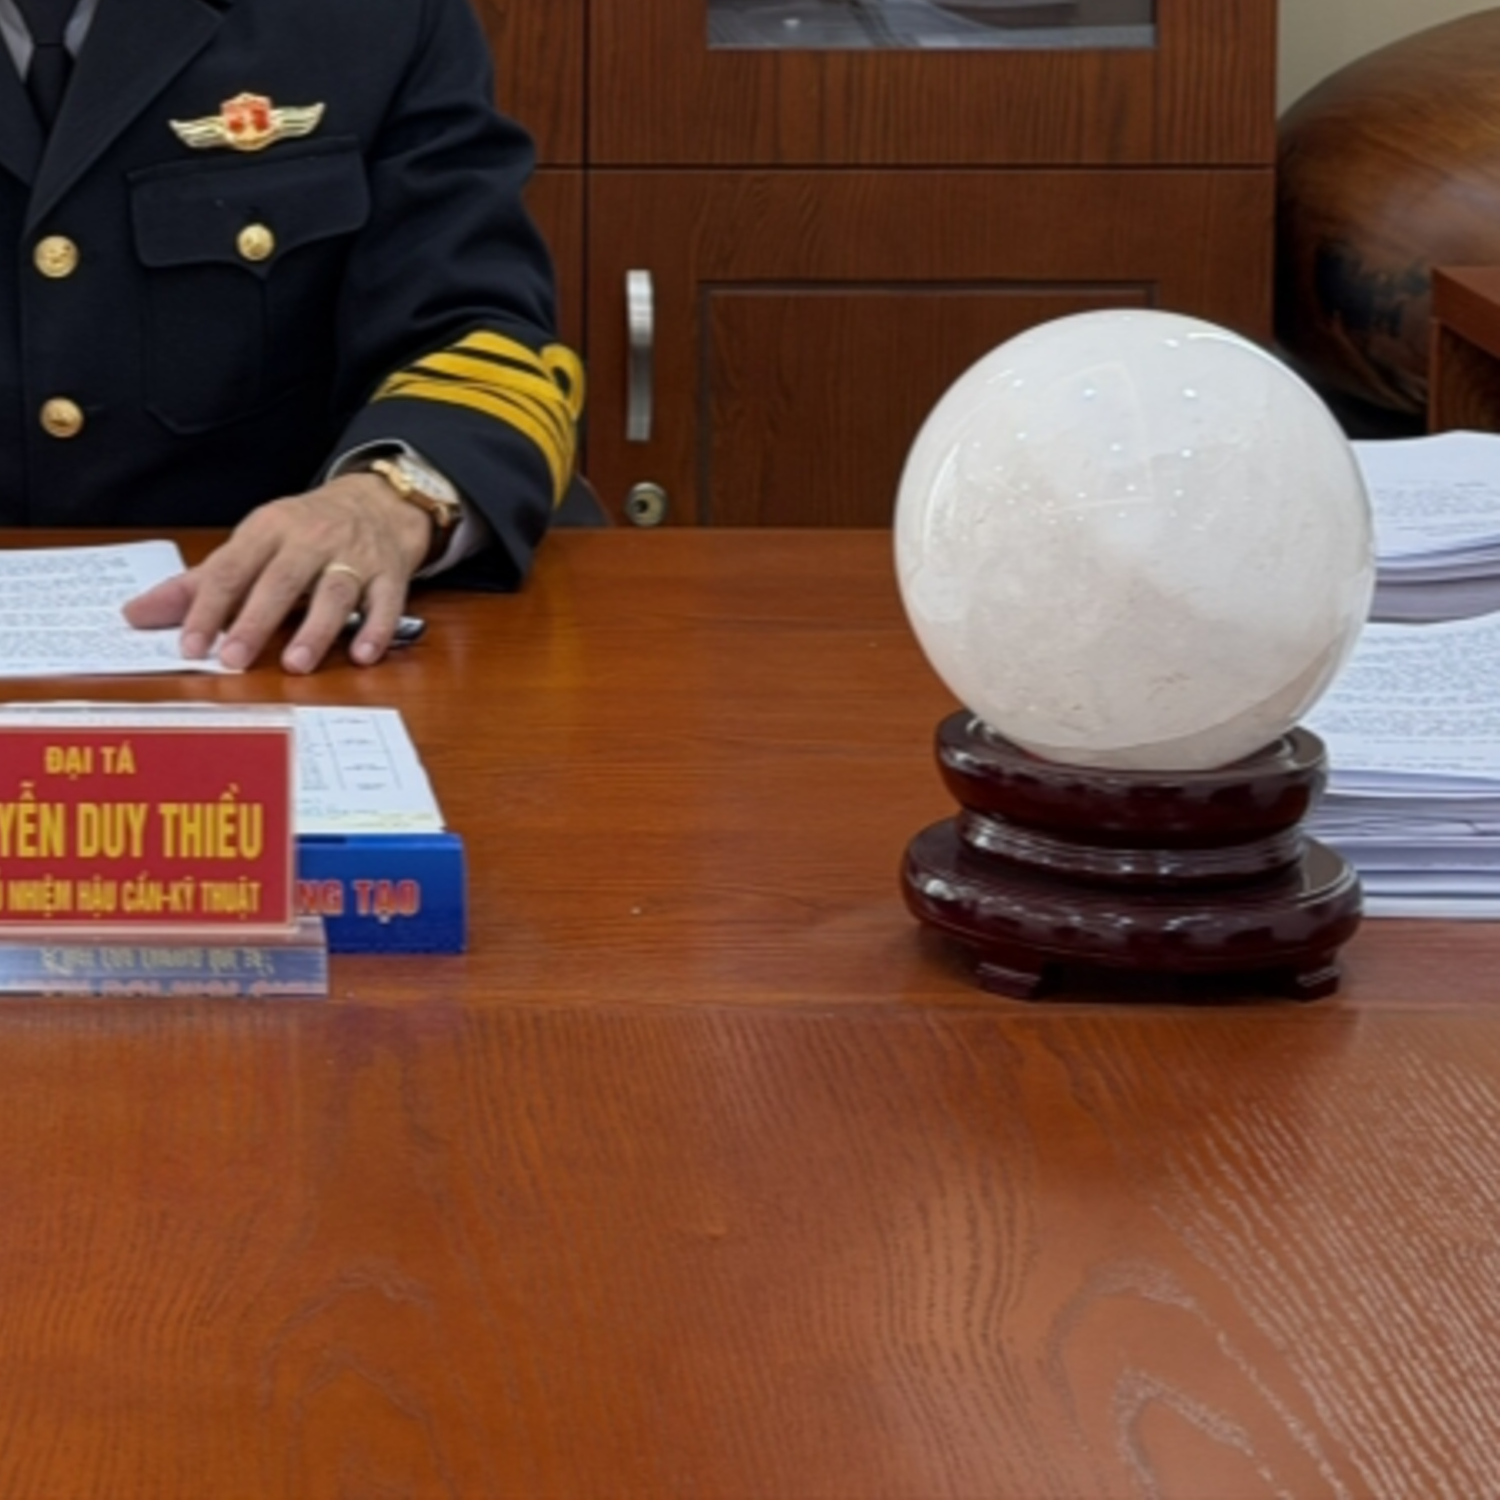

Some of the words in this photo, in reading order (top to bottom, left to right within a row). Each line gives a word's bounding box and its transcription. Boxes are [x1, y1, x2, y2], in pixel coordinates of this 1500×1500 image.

[44, 746, 93, 780] ĐẠI
[99, 740, 136, 774] TÁ
[76, 801, 149, 858] DUY
[158, 783, 263, 858] THIỀU
[7, 873, 73, 918] NHIỆM
[200, 875, 261, 920] THUẬT
[352, 879, 421, 924] TẠO
